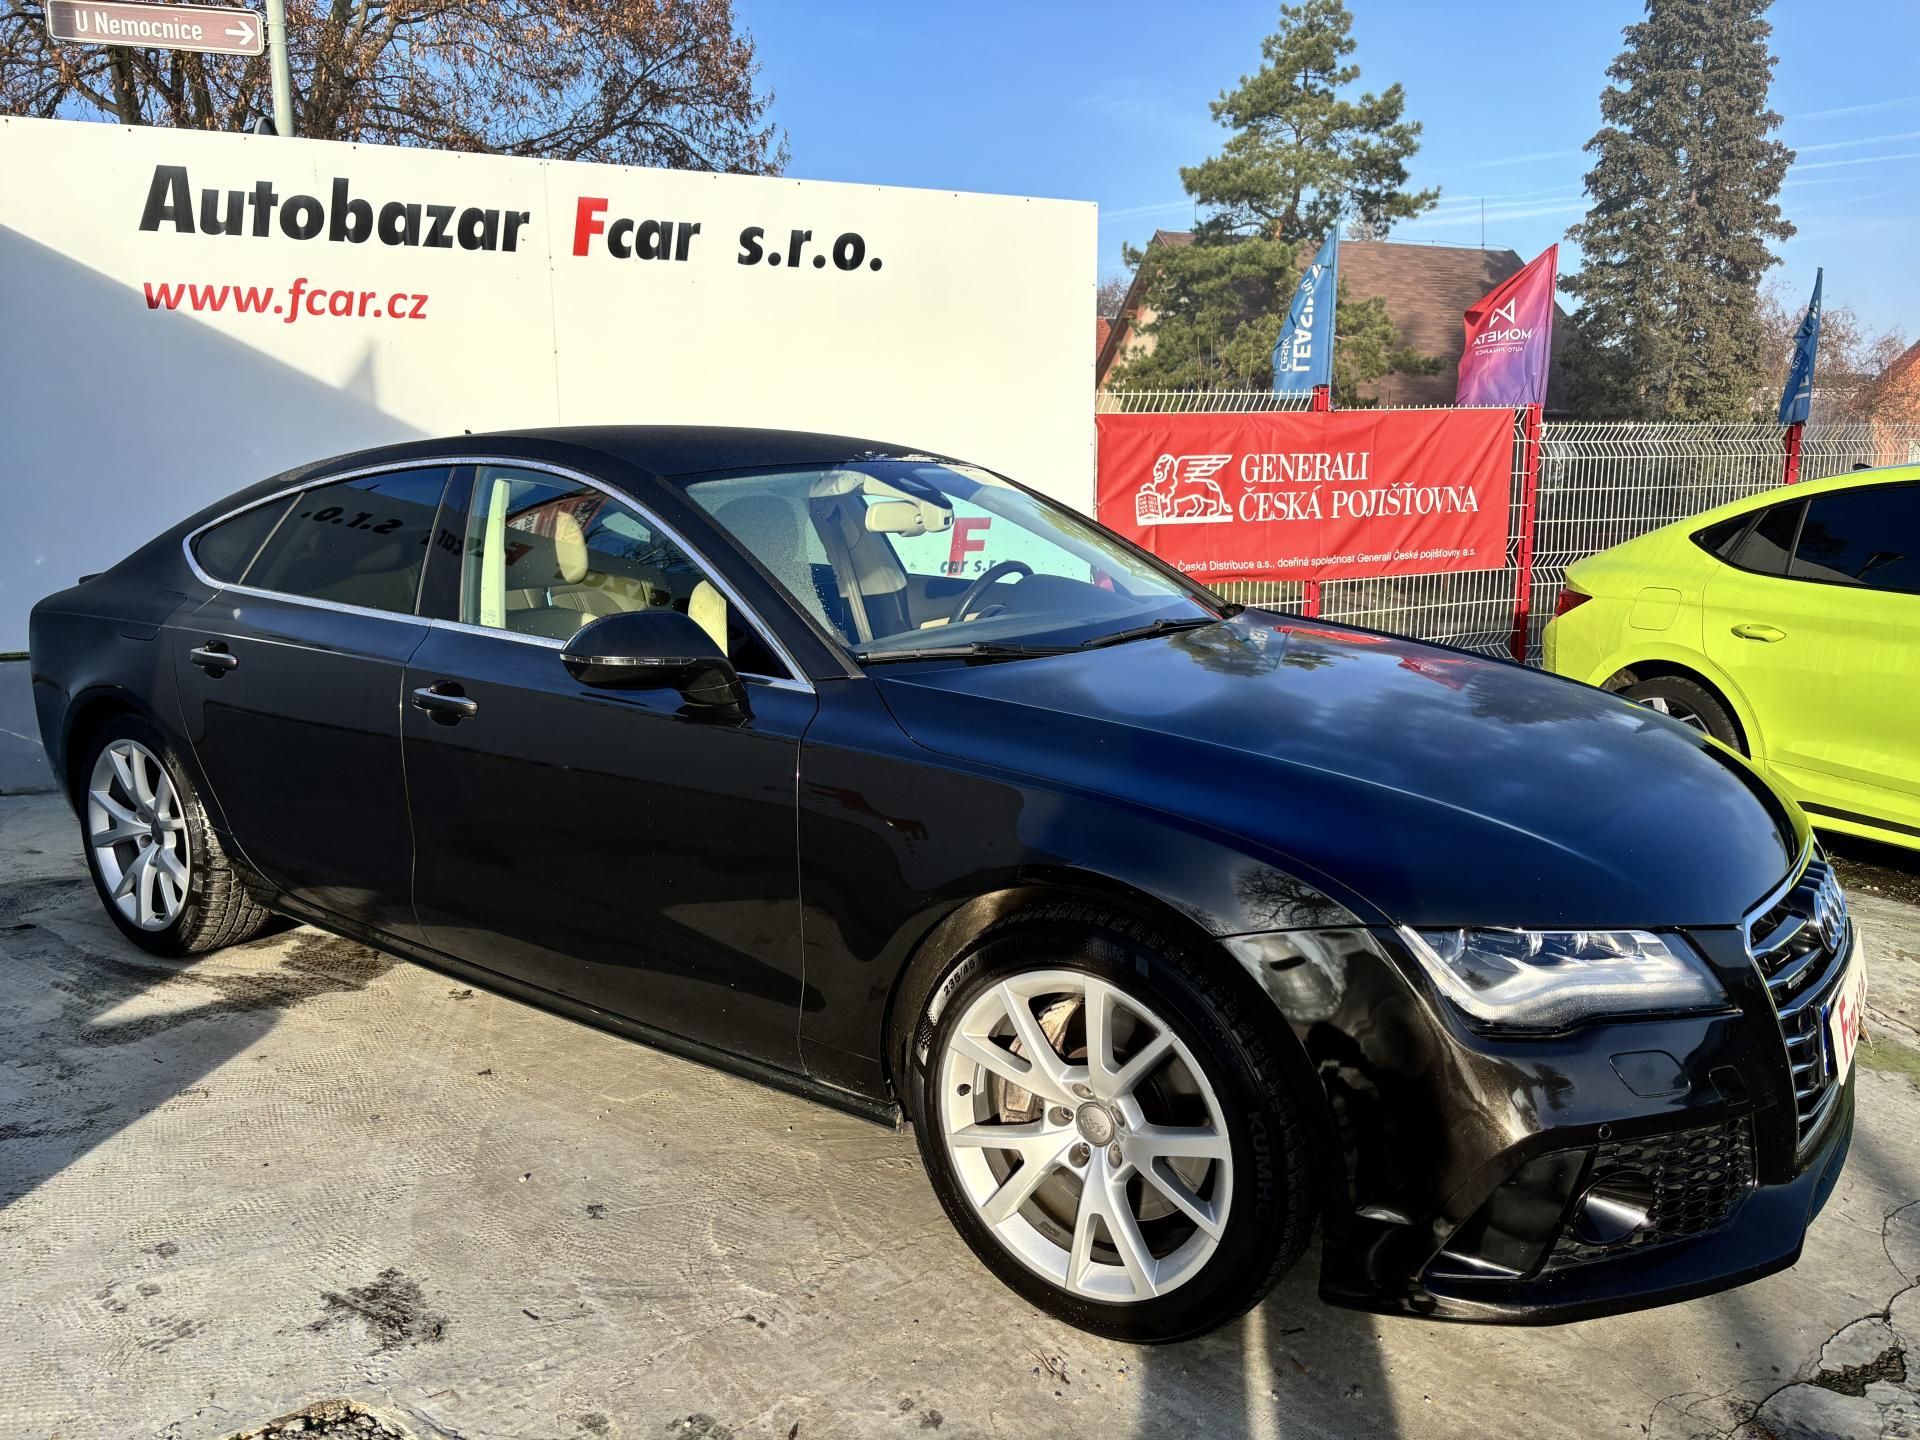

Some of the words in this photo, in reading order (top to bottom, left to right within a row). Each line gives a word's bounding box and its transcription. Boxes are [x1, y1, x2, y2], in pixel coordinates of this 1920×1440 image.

[74, 9, 89, 32] U
[95, 11, 203, 41] Nemocnice
[139, 164, 530, 253] Autobazar
[572, 196, 702, 262] Fcar
[737, 226, 883, 272] s.r.o.
[143, 277, 430, 324] www.fcar.cz
[1240, 452, 1370, 483] GENERALI
[1238, 485, 1324, 522] ČESKÁ
[1330, 481, 1480, 519] POJIŠŤOVNA
[1177, 559, 1207, 573] Česká
[1209, 559, 1254, 571] Distribuce
[1277, 556, 1309, 568] dceřiná
[1311, 553, 1355, 568] společnost
[1357, 551, 1391, 563] Generali
[1393, 550, 1418, 560] České
[1420, 547, 1461, 560] pojišťovny
[1462, 548, 1476, 557] a.s.
